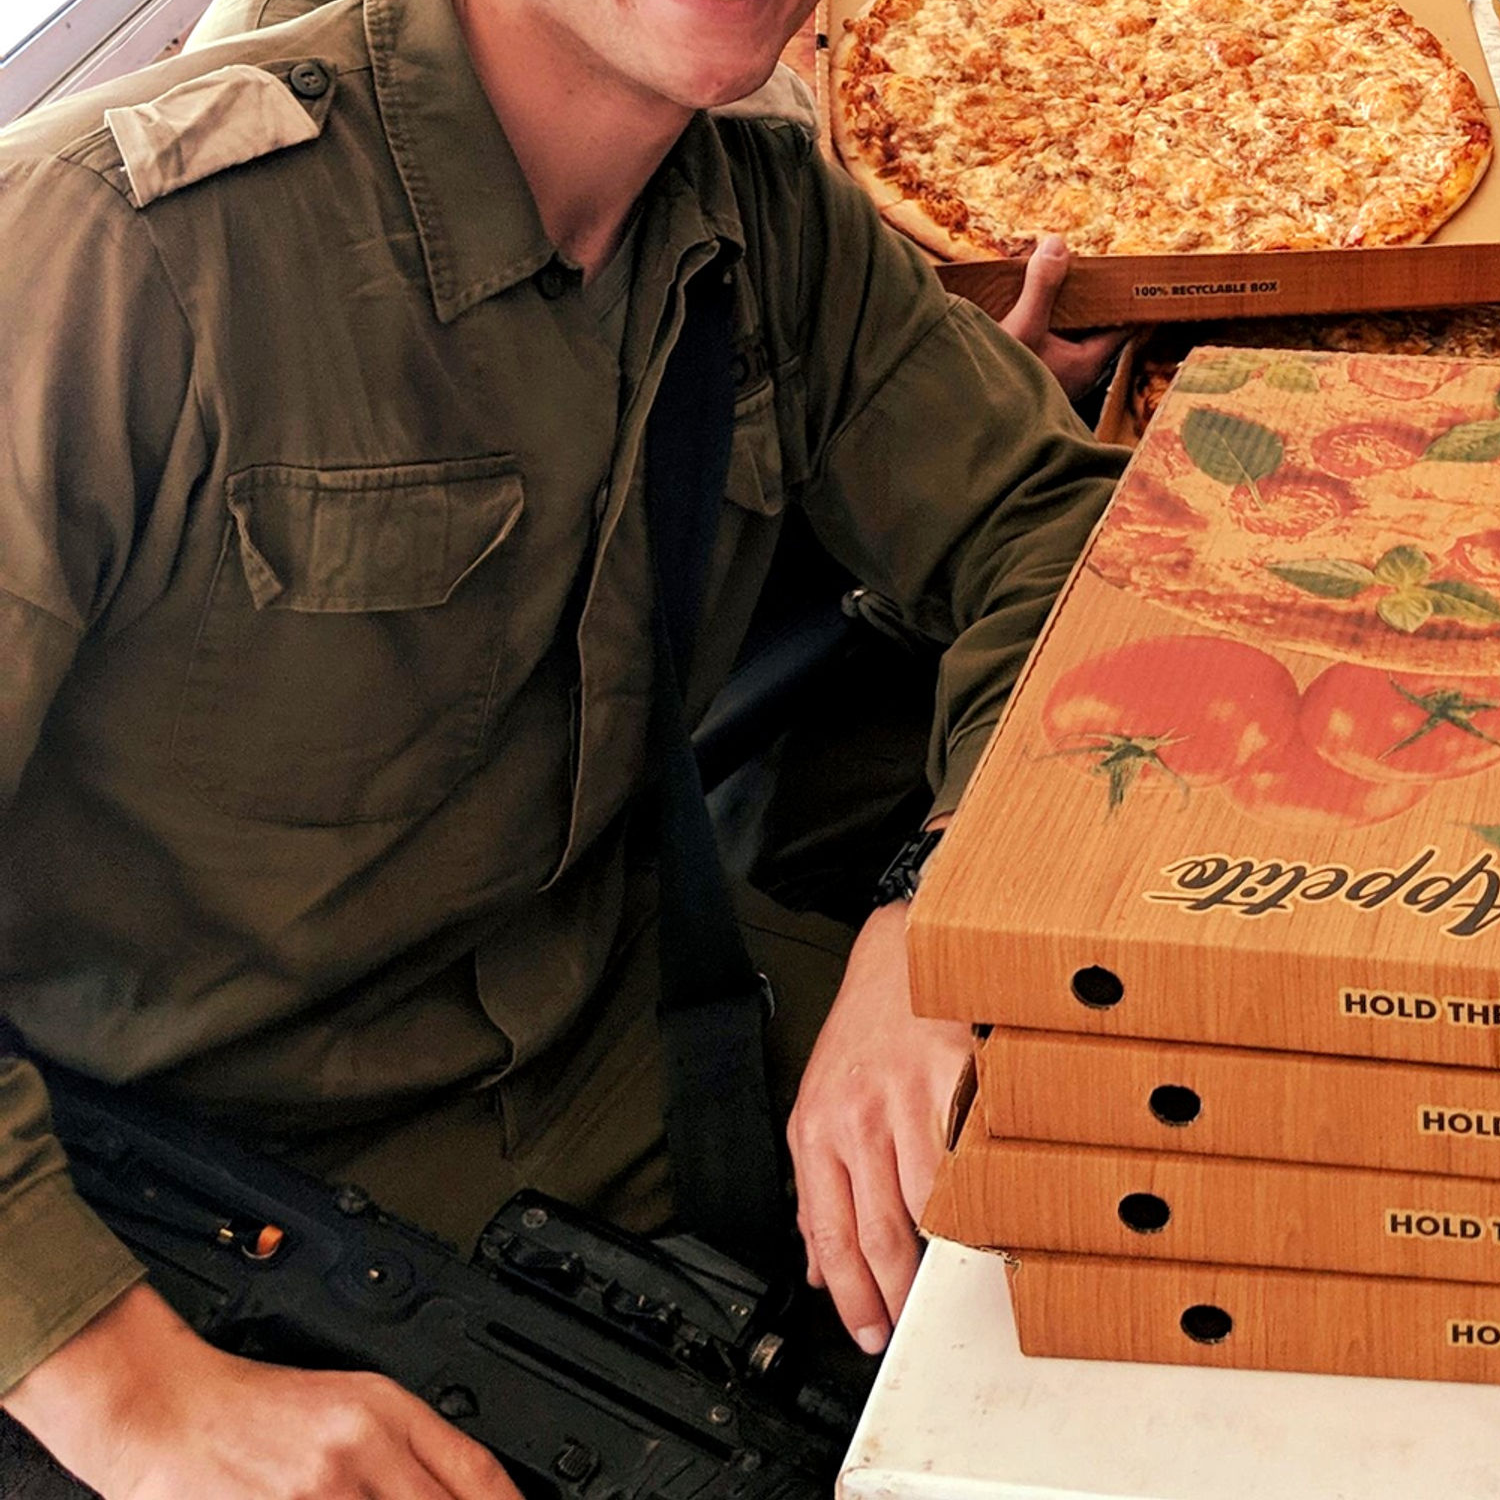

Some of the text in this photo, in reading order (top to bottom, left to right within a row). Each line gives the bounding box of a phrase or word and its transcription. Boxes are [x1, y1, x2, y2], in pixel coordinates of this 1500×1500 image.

[1135, 281, 1278, 297] 100% RECYCLABLE BOX
[1344, 993, 1437, 1019] HOLD
[1390, 1214, 1482, 1239] HOLD
